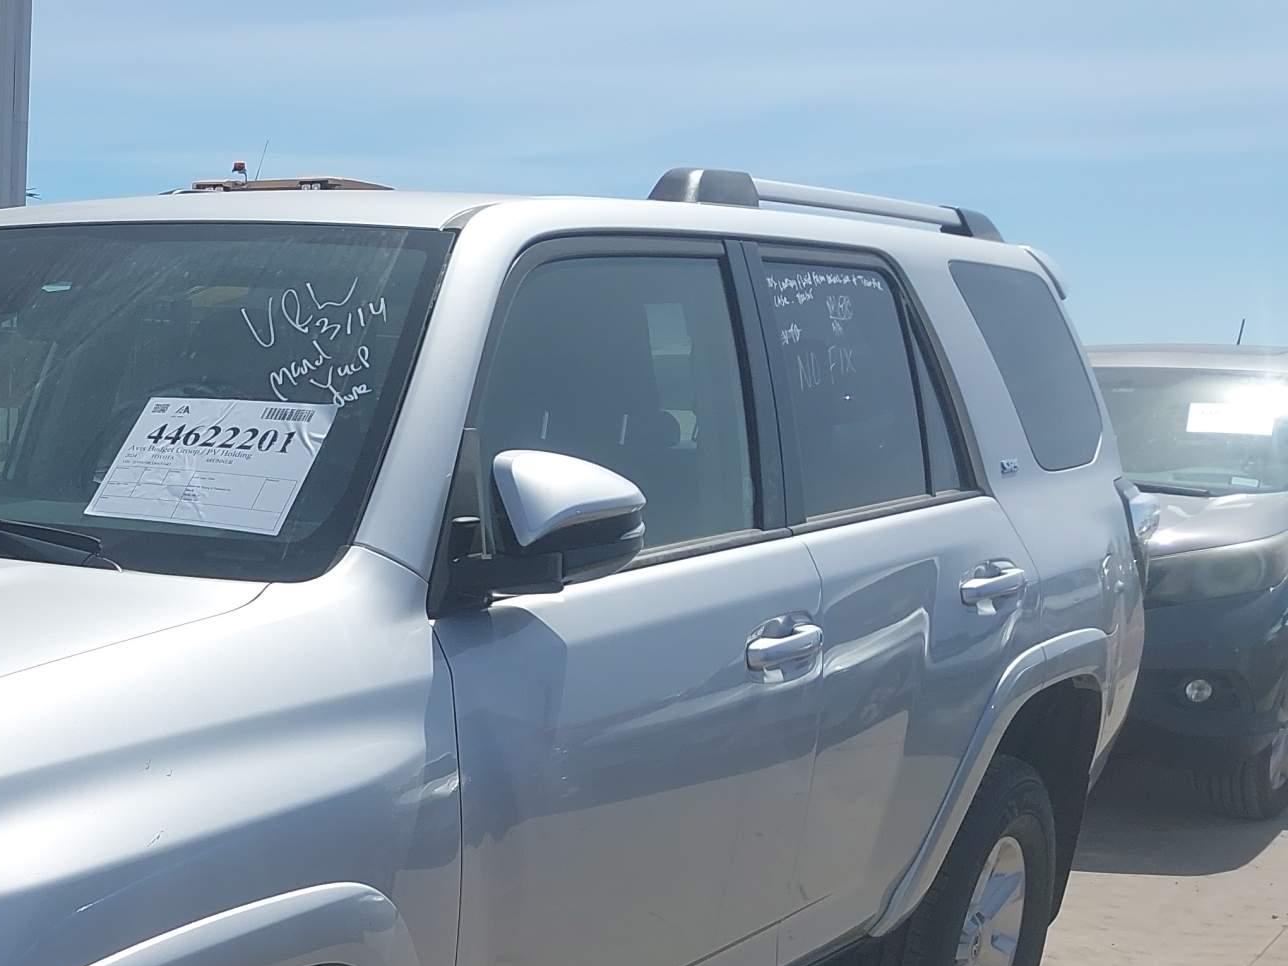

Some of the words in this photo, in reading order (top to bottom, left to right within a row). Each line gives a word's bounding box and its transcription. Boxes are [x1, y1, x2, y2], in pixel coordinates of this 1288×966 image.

[147, 422, 297, 454] 44622201
[128, 444, 146, 452] Avis
[148, 444, 175, 453] Budget
[175, 447, 200, 456] Group
[221, 449, 253, 460] Holding
